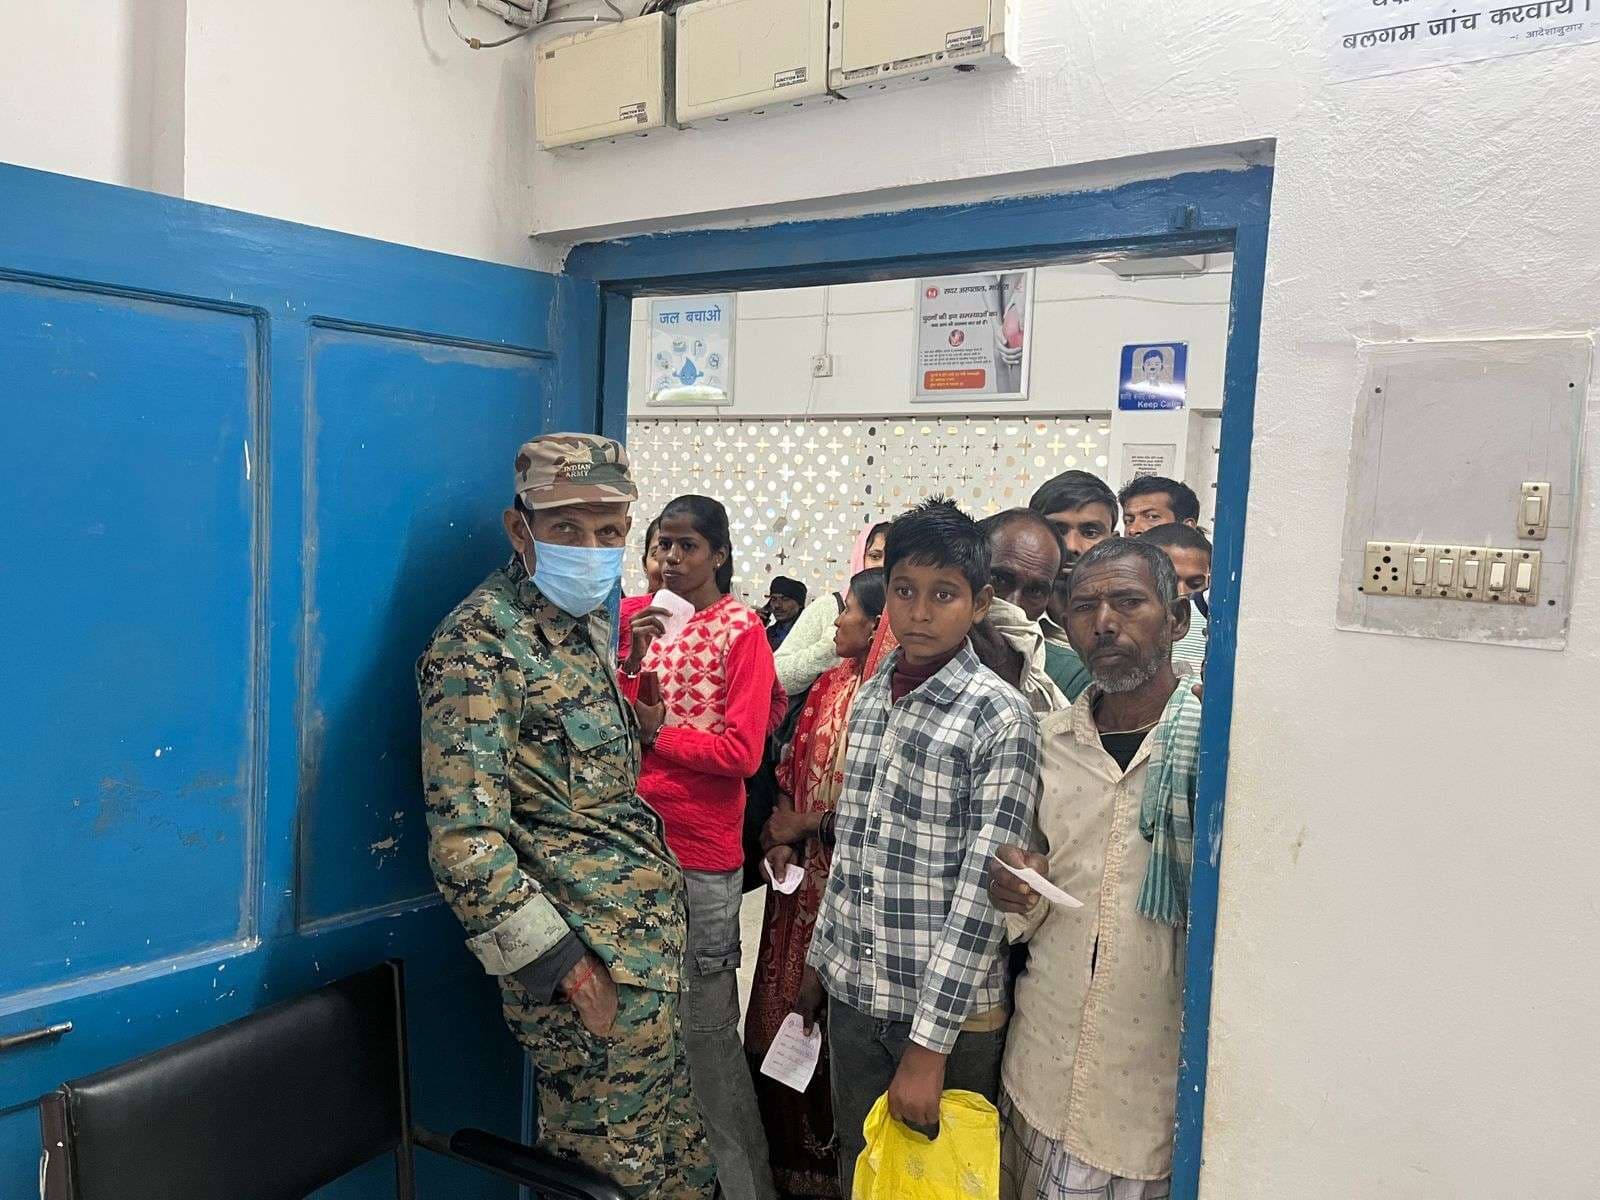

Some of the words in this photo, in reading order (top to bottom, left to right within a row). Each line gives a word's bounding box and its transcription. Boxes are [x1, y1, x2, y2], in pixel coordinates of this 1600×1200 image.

[1343, 22, 1420, 49] बलगम
[1427, 9, 1481, 36] जांच
[1525, 22, 1584, 38] आदेशानुसार
[659, 312, 680, 324] जल
[685, 304, 721, 322] बचाओ
[1137, 401, 1158, 409] Keep
[562, 463, 591, 472] INDIAN
[566, 470, 589, 478] ARMY
